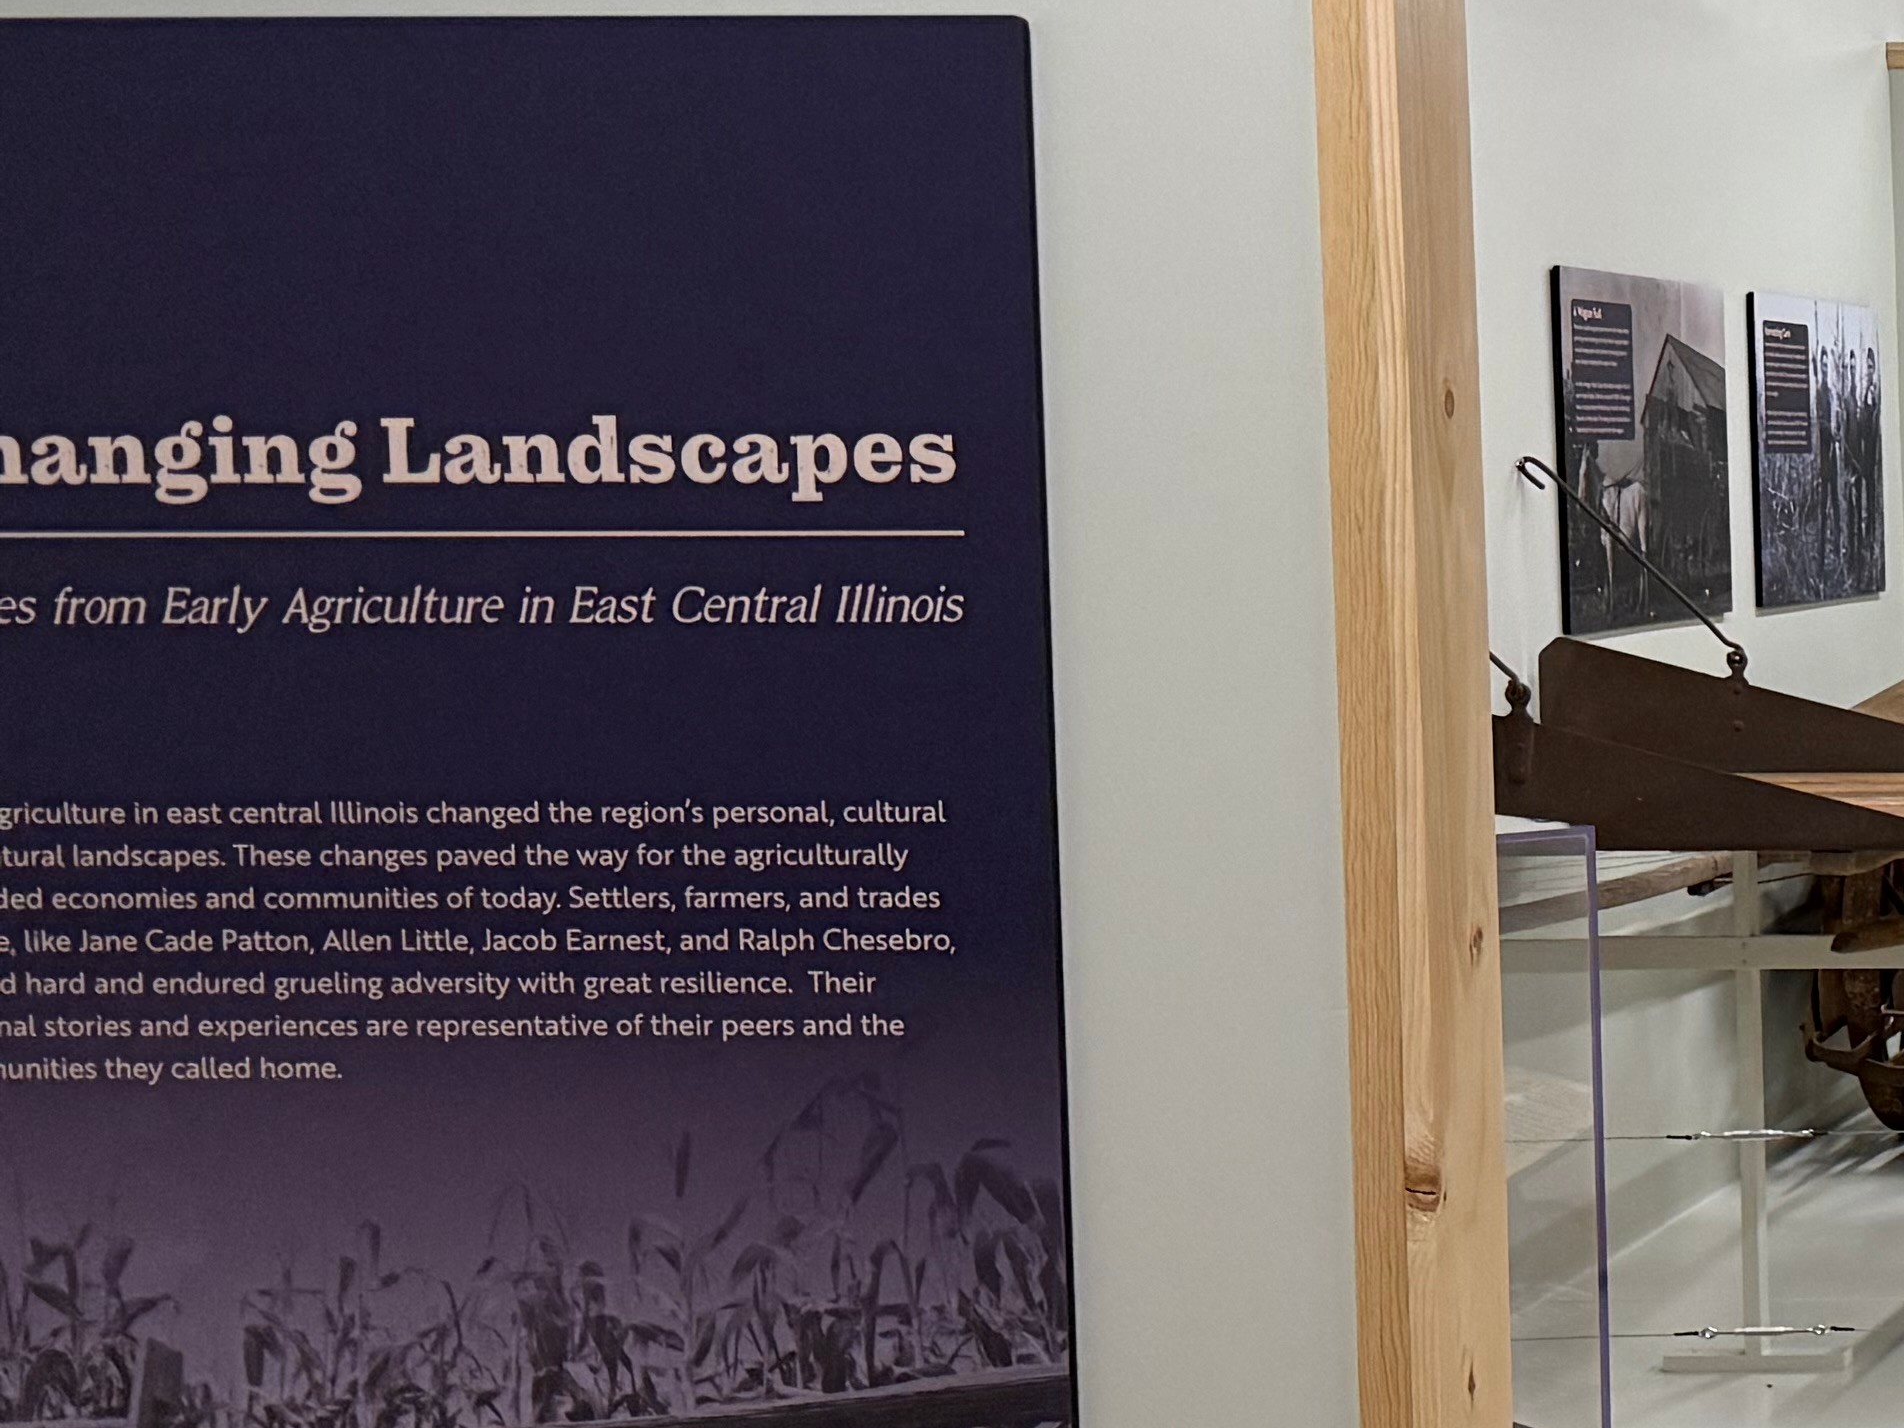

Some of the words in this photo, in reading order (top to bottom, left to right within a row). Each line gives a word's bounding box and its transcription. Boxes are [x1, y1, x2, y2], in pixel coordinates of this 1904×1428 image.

[380, 414, 957, 502] Landscapes
[53, 586, 147, 625] from
[161, 584, 269, 634] Early
[281, 584, 505, 634] Agriculture
[518, 585, 555, 624] in
[568, 585, 657, 624] East
[672, 583, 822, 624] Central
[835, 583, 965, 623] Illinois
[134, 801, 159, 825] in
[166, 803, 223, 825] east
[229, 800, 323, 825] central
[330, 800, 419, 824] Illinois
[426, 800, 540, 830] changed
[547, 800, 593, 824] the
[601, 797, 704, 829] region's
[712, 799, 835, 829] personal,
[843, 799, 947, 823] cultural
[73, 843, 226, 873] landscapes.
[232, 843, 312, 867] These
[319, 843, 428, 873] changes
[436, 843, 516, 872] paved
[524, 843, 569, 867] the
[575, 849, 629, 873] way
[636, 842, 675, 866] for
[681, 843, 726, 866] the
[734, 842, 909, 872] agriculturally
[51, 887, 198, 910] economies
[205, 886, 255, 910] and
[263, 886, 439, 910] communities
[446, 885, 474, 909] of
[480, 885, 562, 915] today.
[568, 885, 676, 913] Settlers,
[684, 885, 791, 912] farmers,
[799, 885, 849, 909] and
[856, 885, 941, 909] trades
[24, 929, 71, 953] like
[78, 929, 138, 953] Jane
[145, 928, 213, 952] Cade
[222, 928, 315, 955] Patton,
[322, 928, 392, 952] Allen
[401, 928, 475, 955] Little,
[482, 928, 557, 952] Jacob
[566, 928, 672, 955] Earnest,
[679, 927, 729, 951] and
[738, 927, 815, 957] Ralph
[822, 927, 956, 955] Chesebro,
[25, 971, 85, 995] hard
[94, 971, 144, 995] and
[152, 971, 265, 995] endured
[274, 971, 384, 1001] grueling
[390, 970, 511, 1001] adversity
[517, 971, 575, 994] with
[583, 972, 653, 1000] great
[660, 970, 793, 994] resilience.
[807, 970, 877, 994] Their
[44, 1014, 132, 1037] stories
[139, 1014, 189, 1037] and
[198, 1014, 359, 1043] experiences
[366, 1019, 409, 1037] are
[416, 1013, 608, 1043] representative
[616, 1012, 644, 1036] of
[650, 1013, 714, 1037] their
[722, 1019, 795, 1042] peers
[802, 1012, 852, 1036] and
[860, 1013, 905, 1036] the
[104, 1056, 164, 1086] they
[170, 1056, 251, 1080] called
[260, 1056, 343, 1080] home.
